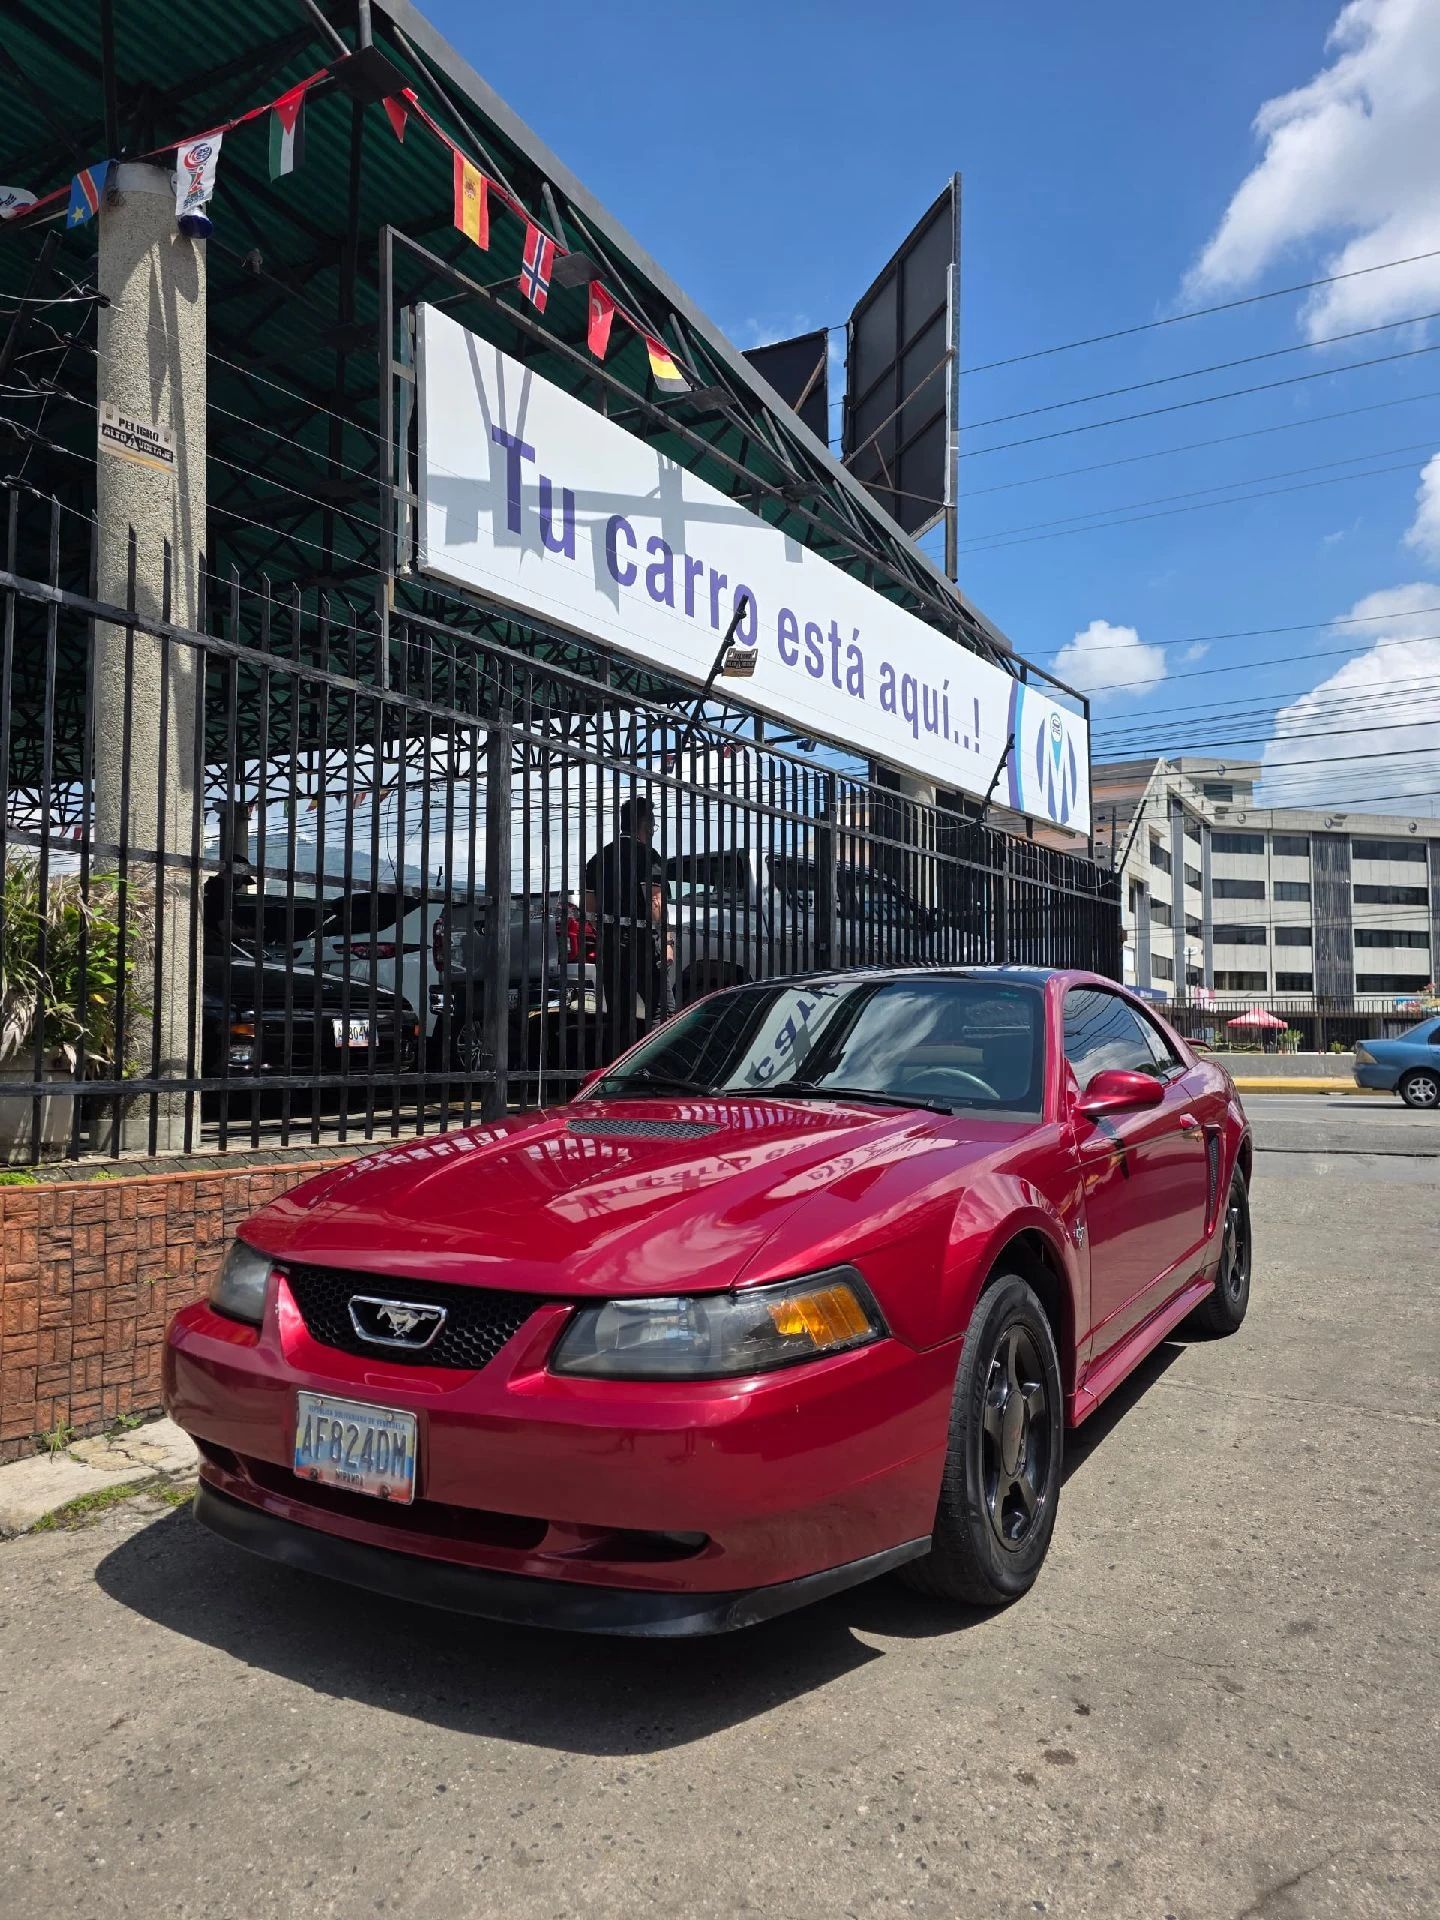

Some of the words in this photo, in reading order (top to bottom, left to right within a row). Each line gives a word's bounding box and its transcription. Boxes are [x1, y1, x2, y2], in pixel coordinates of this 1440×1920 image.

[118, 417, 159, 442] PELIGRO
[491, 424, 576, 561] Tu
[605, 514, 758, 647] carro
[777, 607, 865, 700] está
[301, 1414, 407, 1479] AF824DM
